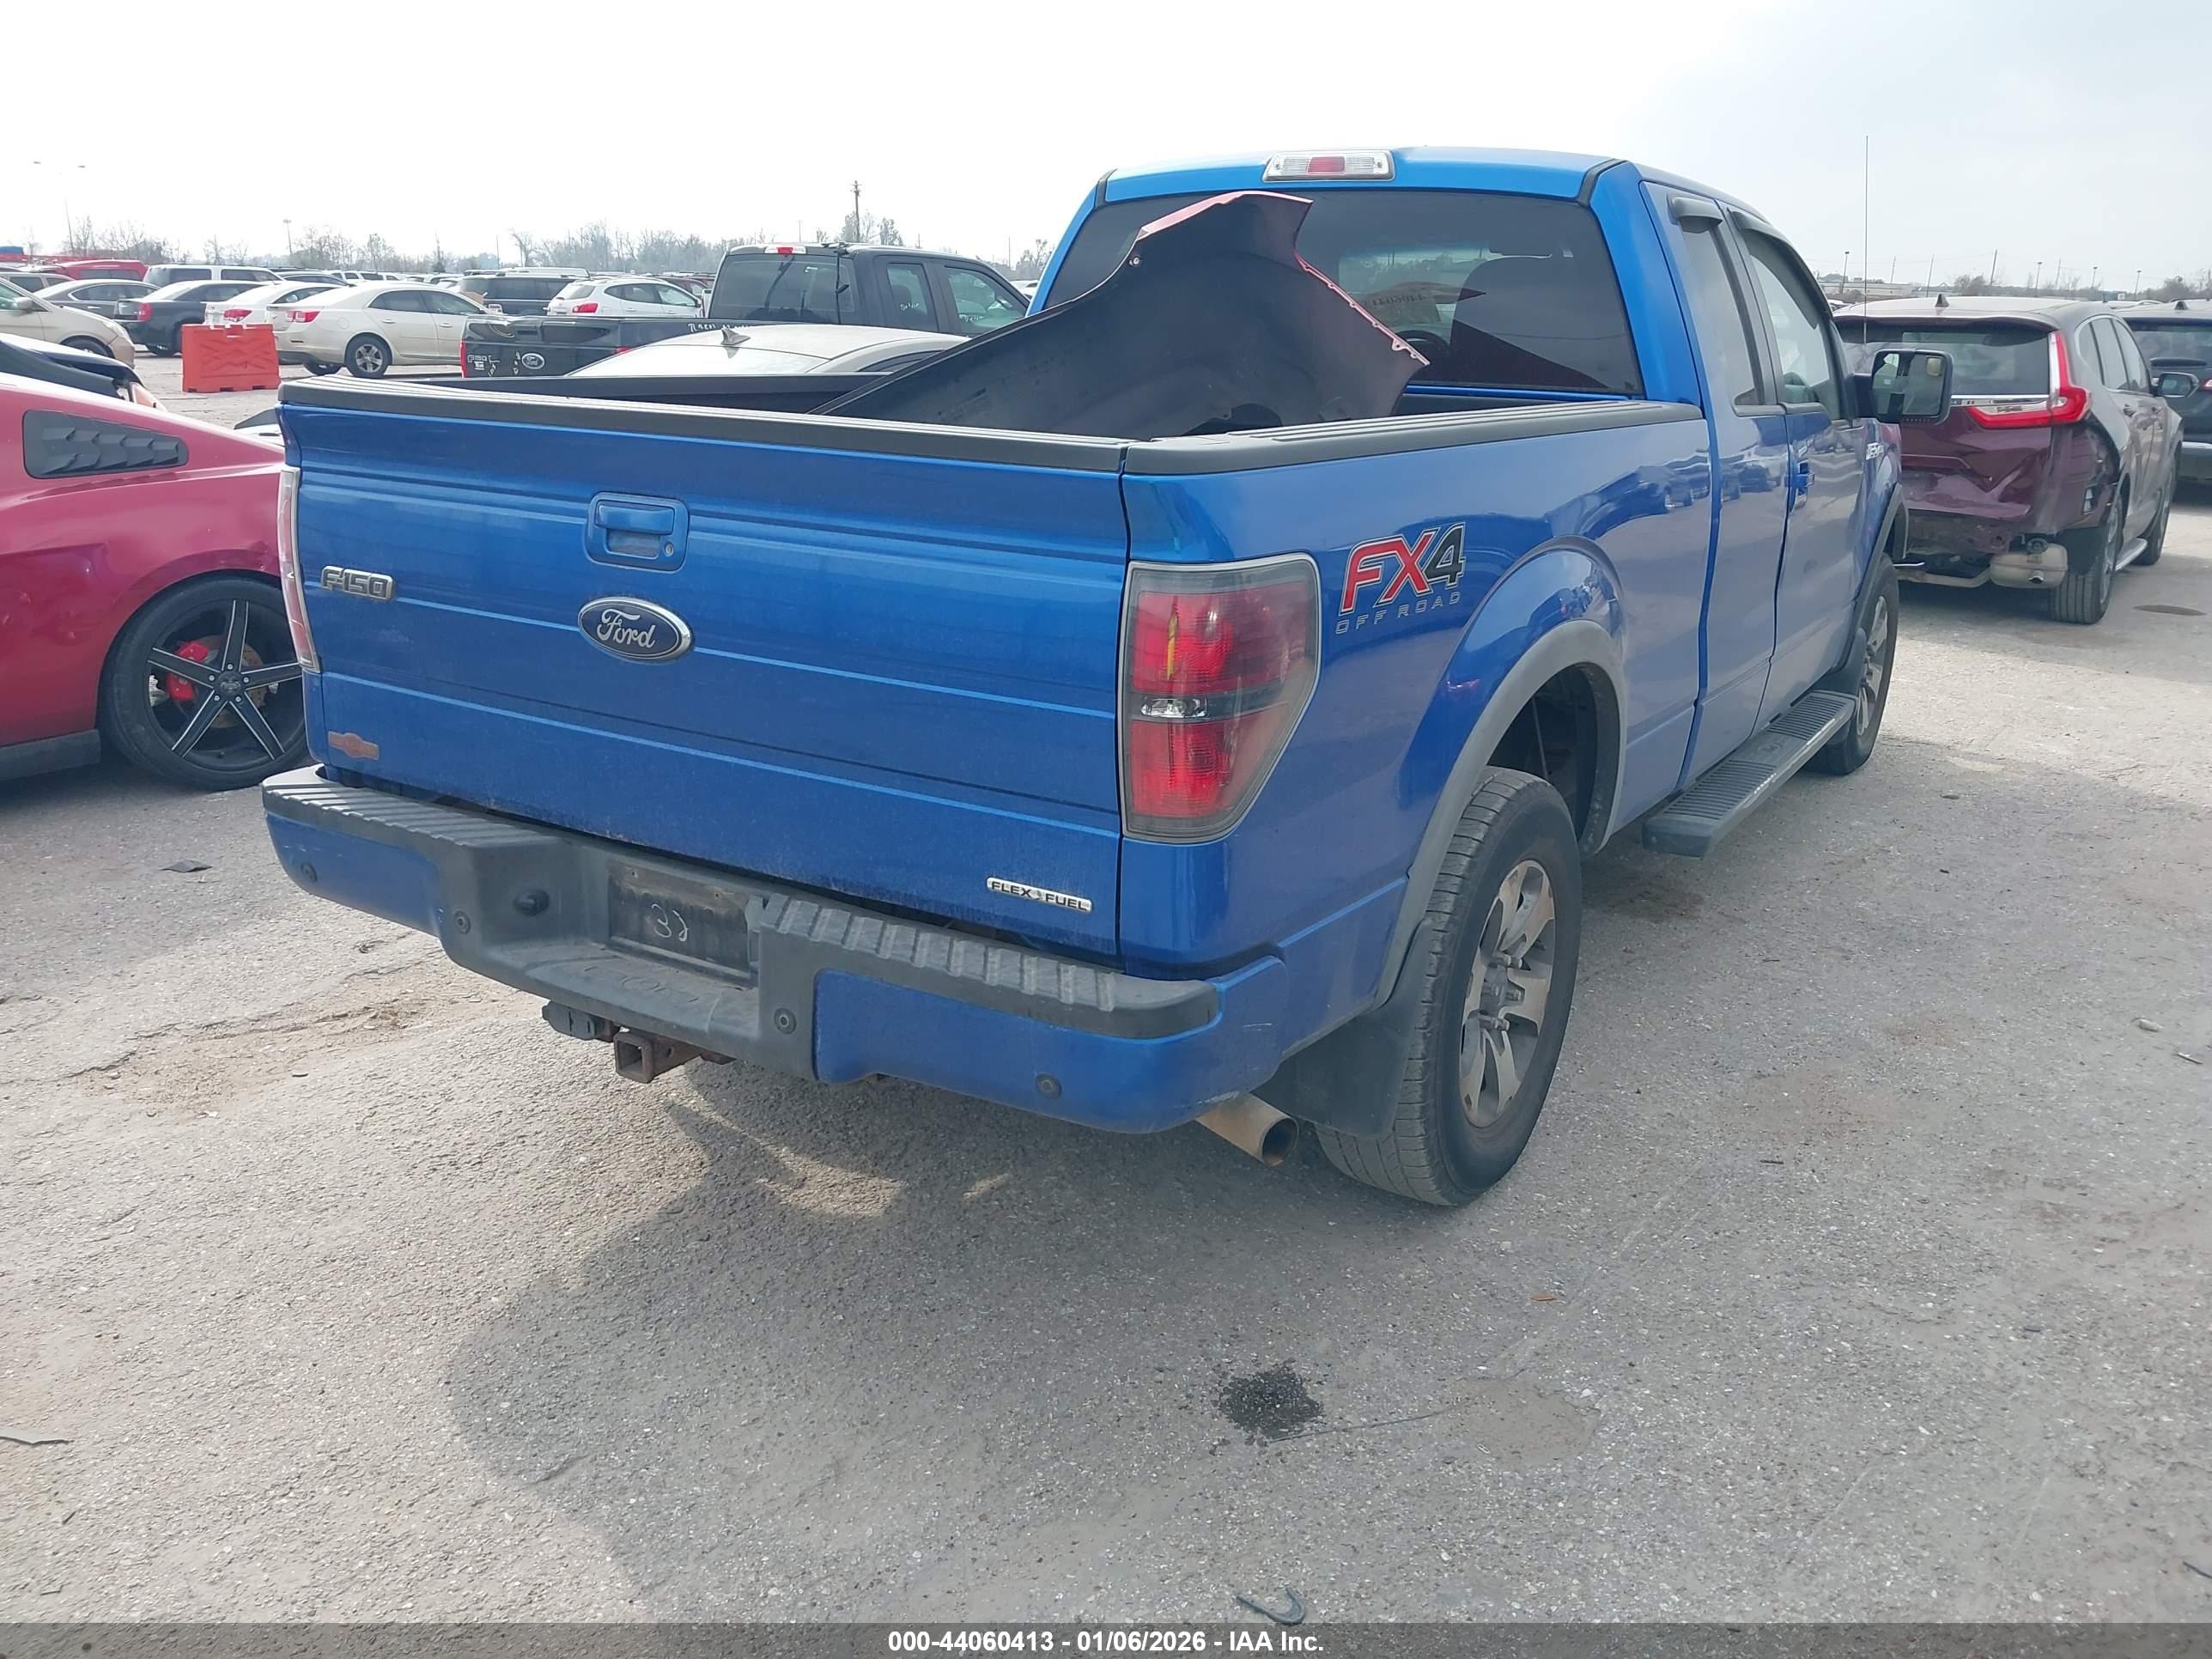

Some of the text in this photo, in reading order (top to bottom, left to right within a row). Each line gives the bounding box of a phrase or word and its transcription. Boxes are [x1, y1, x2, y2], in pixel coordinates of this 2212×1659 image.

[1339, 521, 1467, 617] FX4
[596, 608, 657, 649] Ford
[1335, 591, 1462, 635] OFF ROAD
[991, 881, 1088, 912] FLEX FUEL
